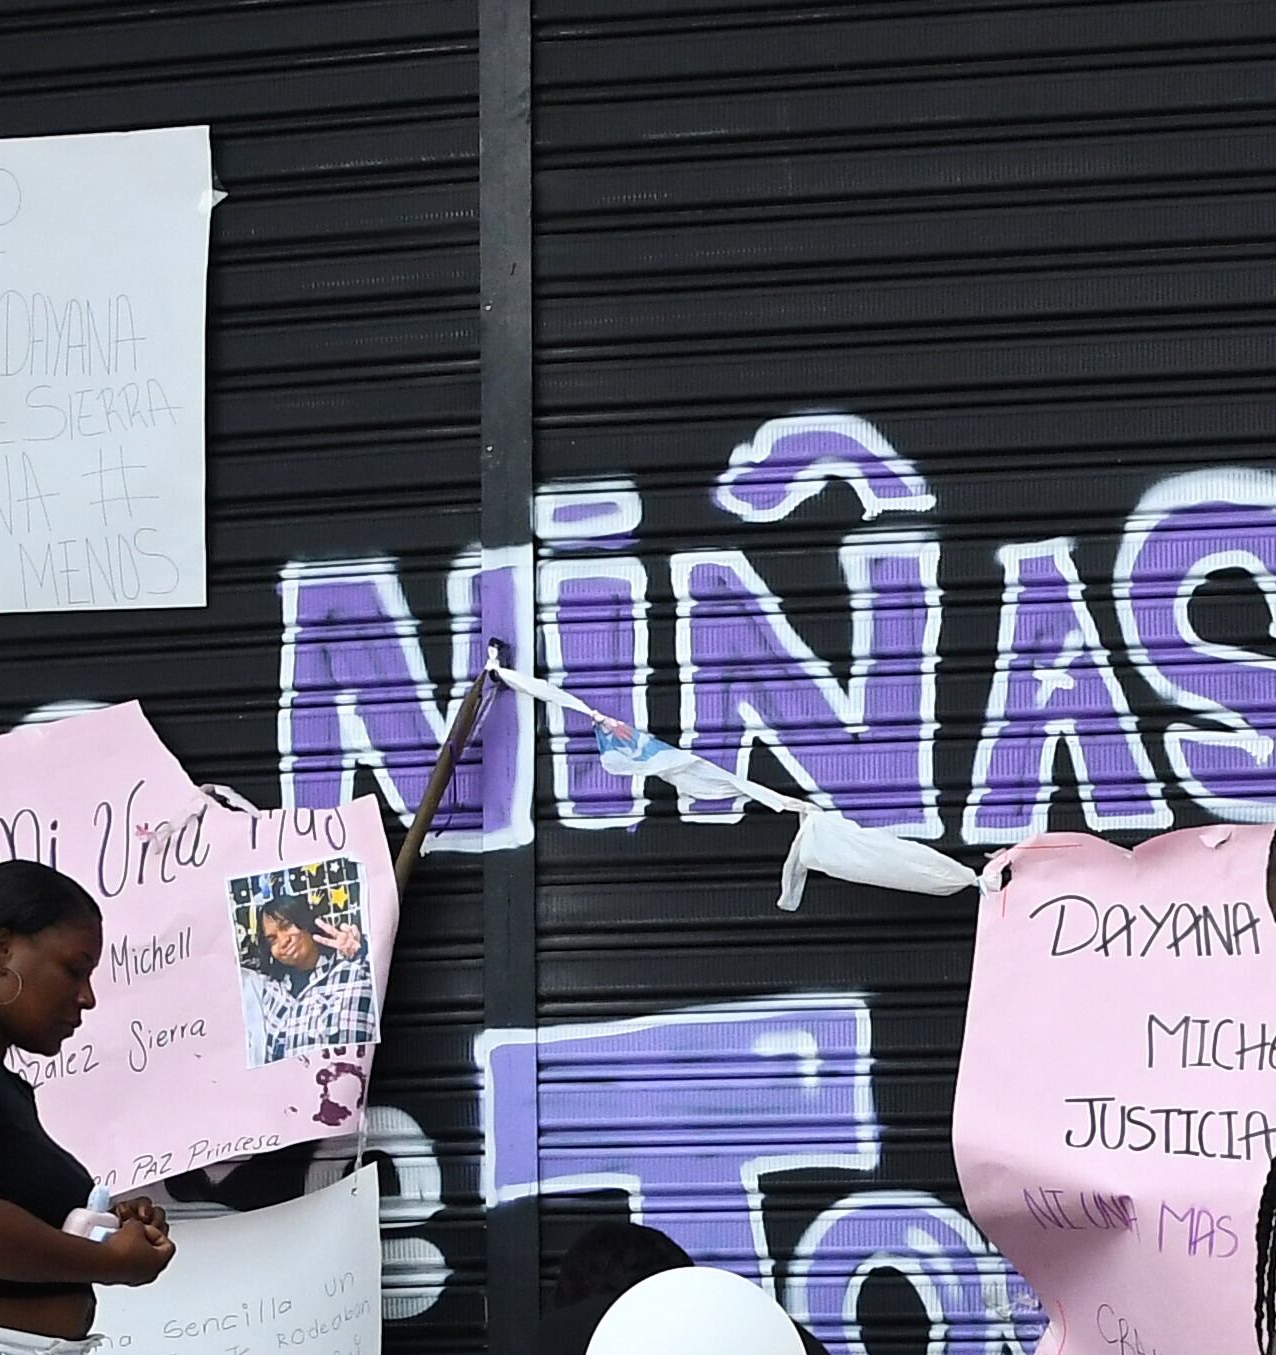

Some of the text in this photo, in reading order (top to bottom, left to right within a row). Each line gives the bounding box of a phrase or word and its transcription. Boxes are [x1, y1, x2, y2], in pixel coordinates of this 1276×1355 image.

[24, 378, 182, 443] SIERRA
[18, 527, 180, 608] MENOS
[110, 926, 193, 987] Michell
[1029, 894, 1261, 958] DAYANA
[129, 1019, 207, 1073] Sierra
[131, 1152, 172, 1185] PAZ
[187, 1134, 281, 1169] Princesa
[1022, 1186, 1086, 1231] NI
[1158, 1200, 1239, 1258] MAS
[164, 1298, 292, 1339] Sencilla
